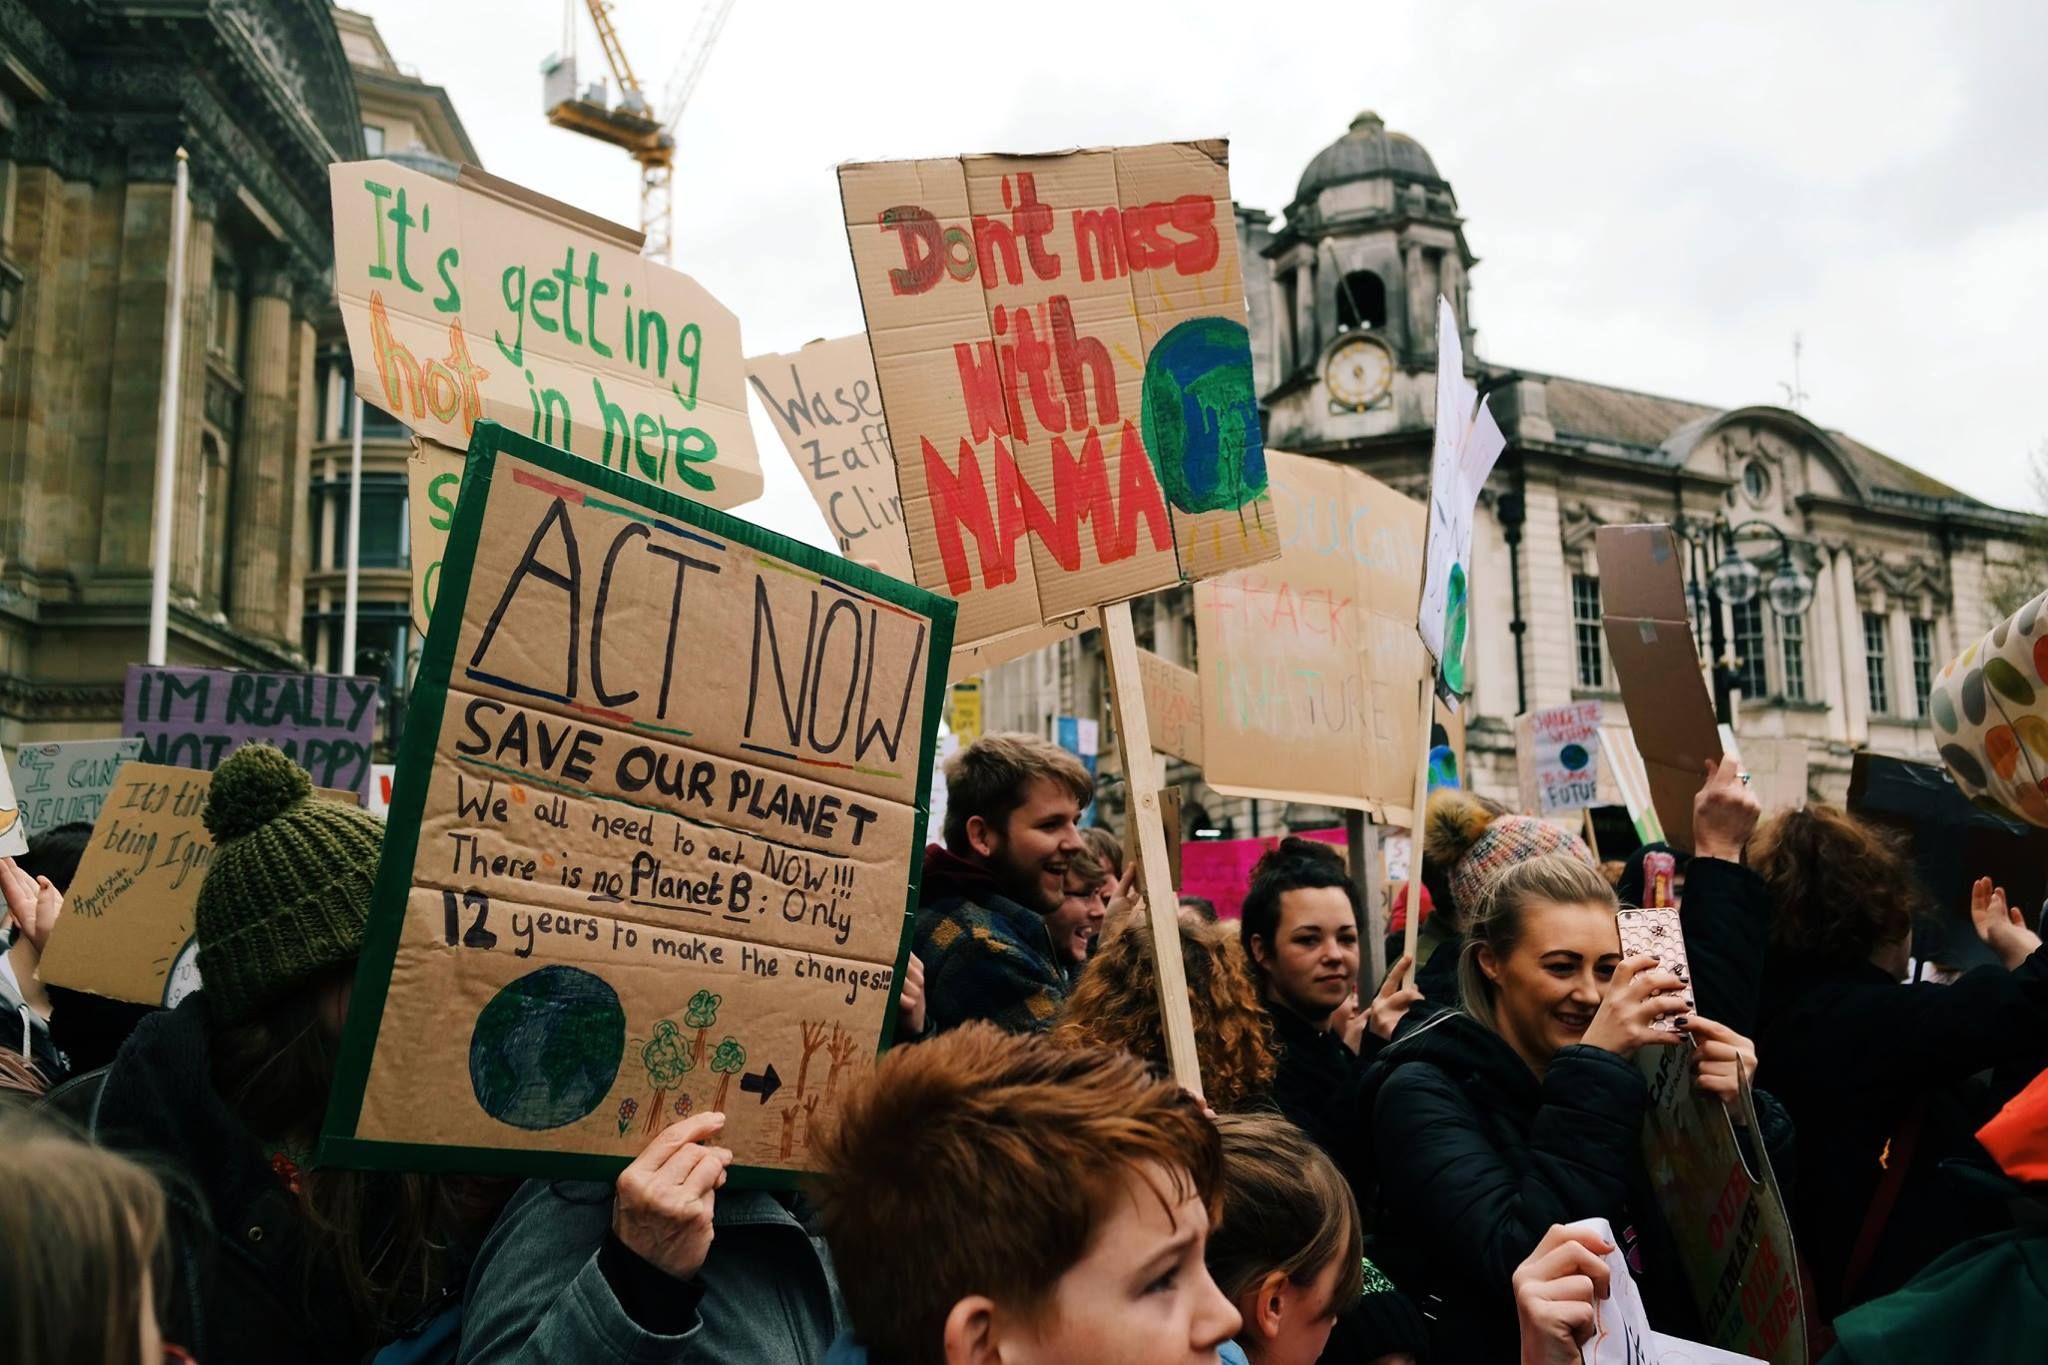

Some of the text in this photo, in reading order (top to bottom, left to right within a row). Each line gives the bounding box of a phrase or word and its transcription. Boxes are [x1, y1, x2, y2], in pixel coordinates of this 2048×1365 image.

[364, 179, 702, 411] It's getting
[878, 171, 1220, 296] Don't mess
[369, 289, 718, 492] hot in here
[471, 497, 926, 762] ACT NOW
[138, 672, 376, 732] I'M REALLY
[25, 762, 55, 793] I
[456, 698, 603, 783] SAVE
[616, 746, 717, 807] OUR
[728, 768, 878, 847] PLANET
[104, 820, 158, 877] being
[448, 832, 537, 882] There
[560, 852, 581, 888] is
[593, 869, 624, 895] no
[630, 850, 724, 905] Planet
[783, 888, 852, 945] Only
[458, 775, 855, 899] We all need to act NOW!!!
[442, 890, 892, 1005] 12 years to make the changes!!!
